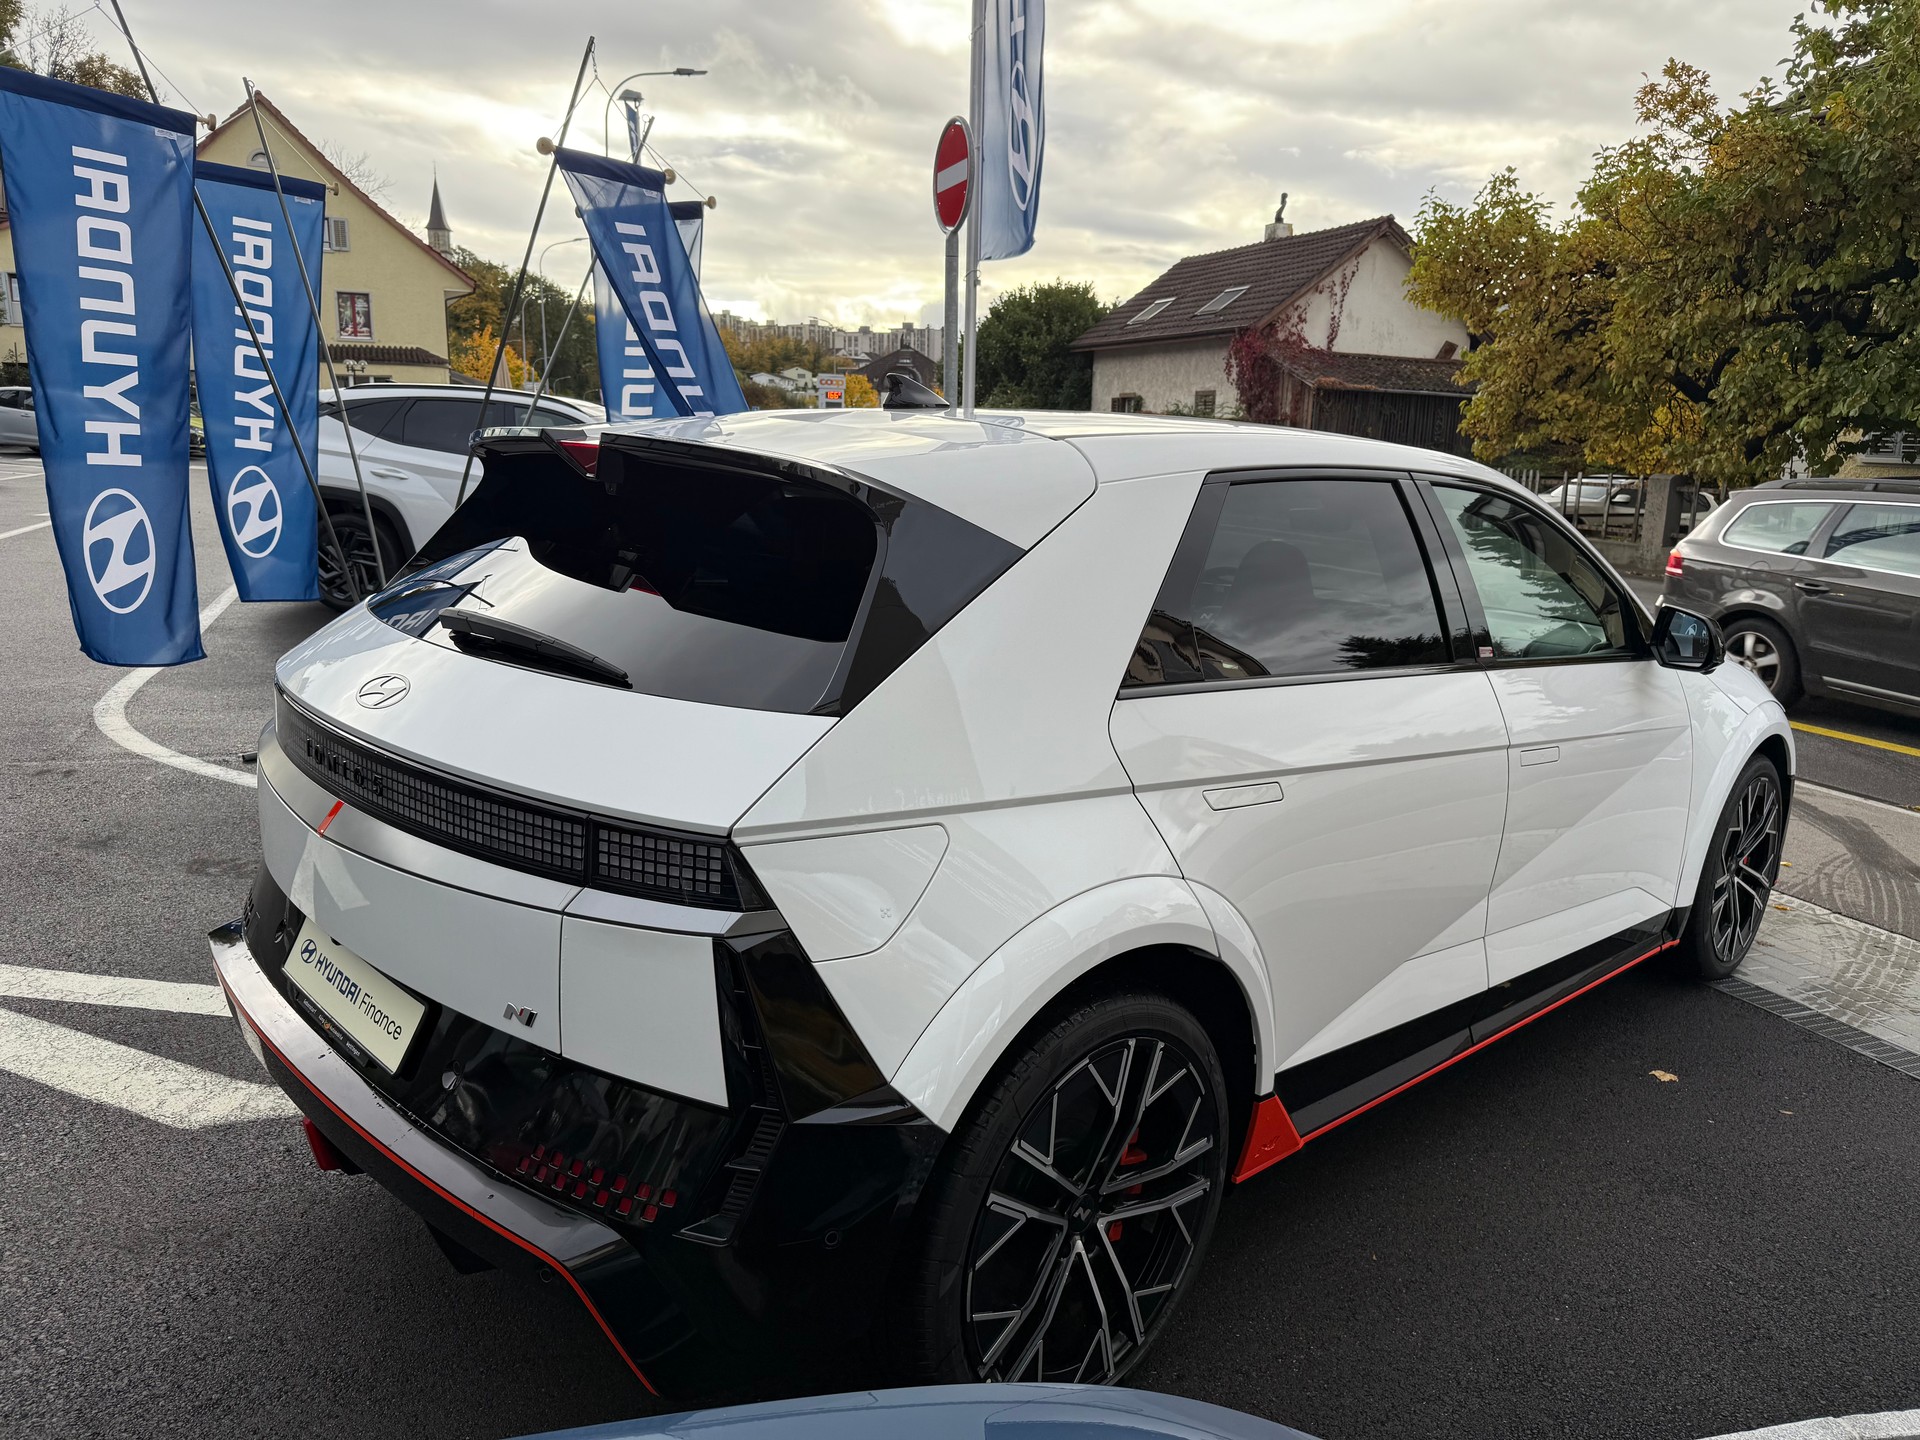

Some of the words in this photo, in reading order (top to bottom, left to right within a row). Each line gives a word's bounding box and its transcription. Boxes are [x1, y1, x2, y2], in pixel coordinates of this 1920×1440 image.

[373, 774, 384, 797] 5
[314, 952, 361, 1005] HYUNDAI
[358, 992, 402, 1040] Finance
